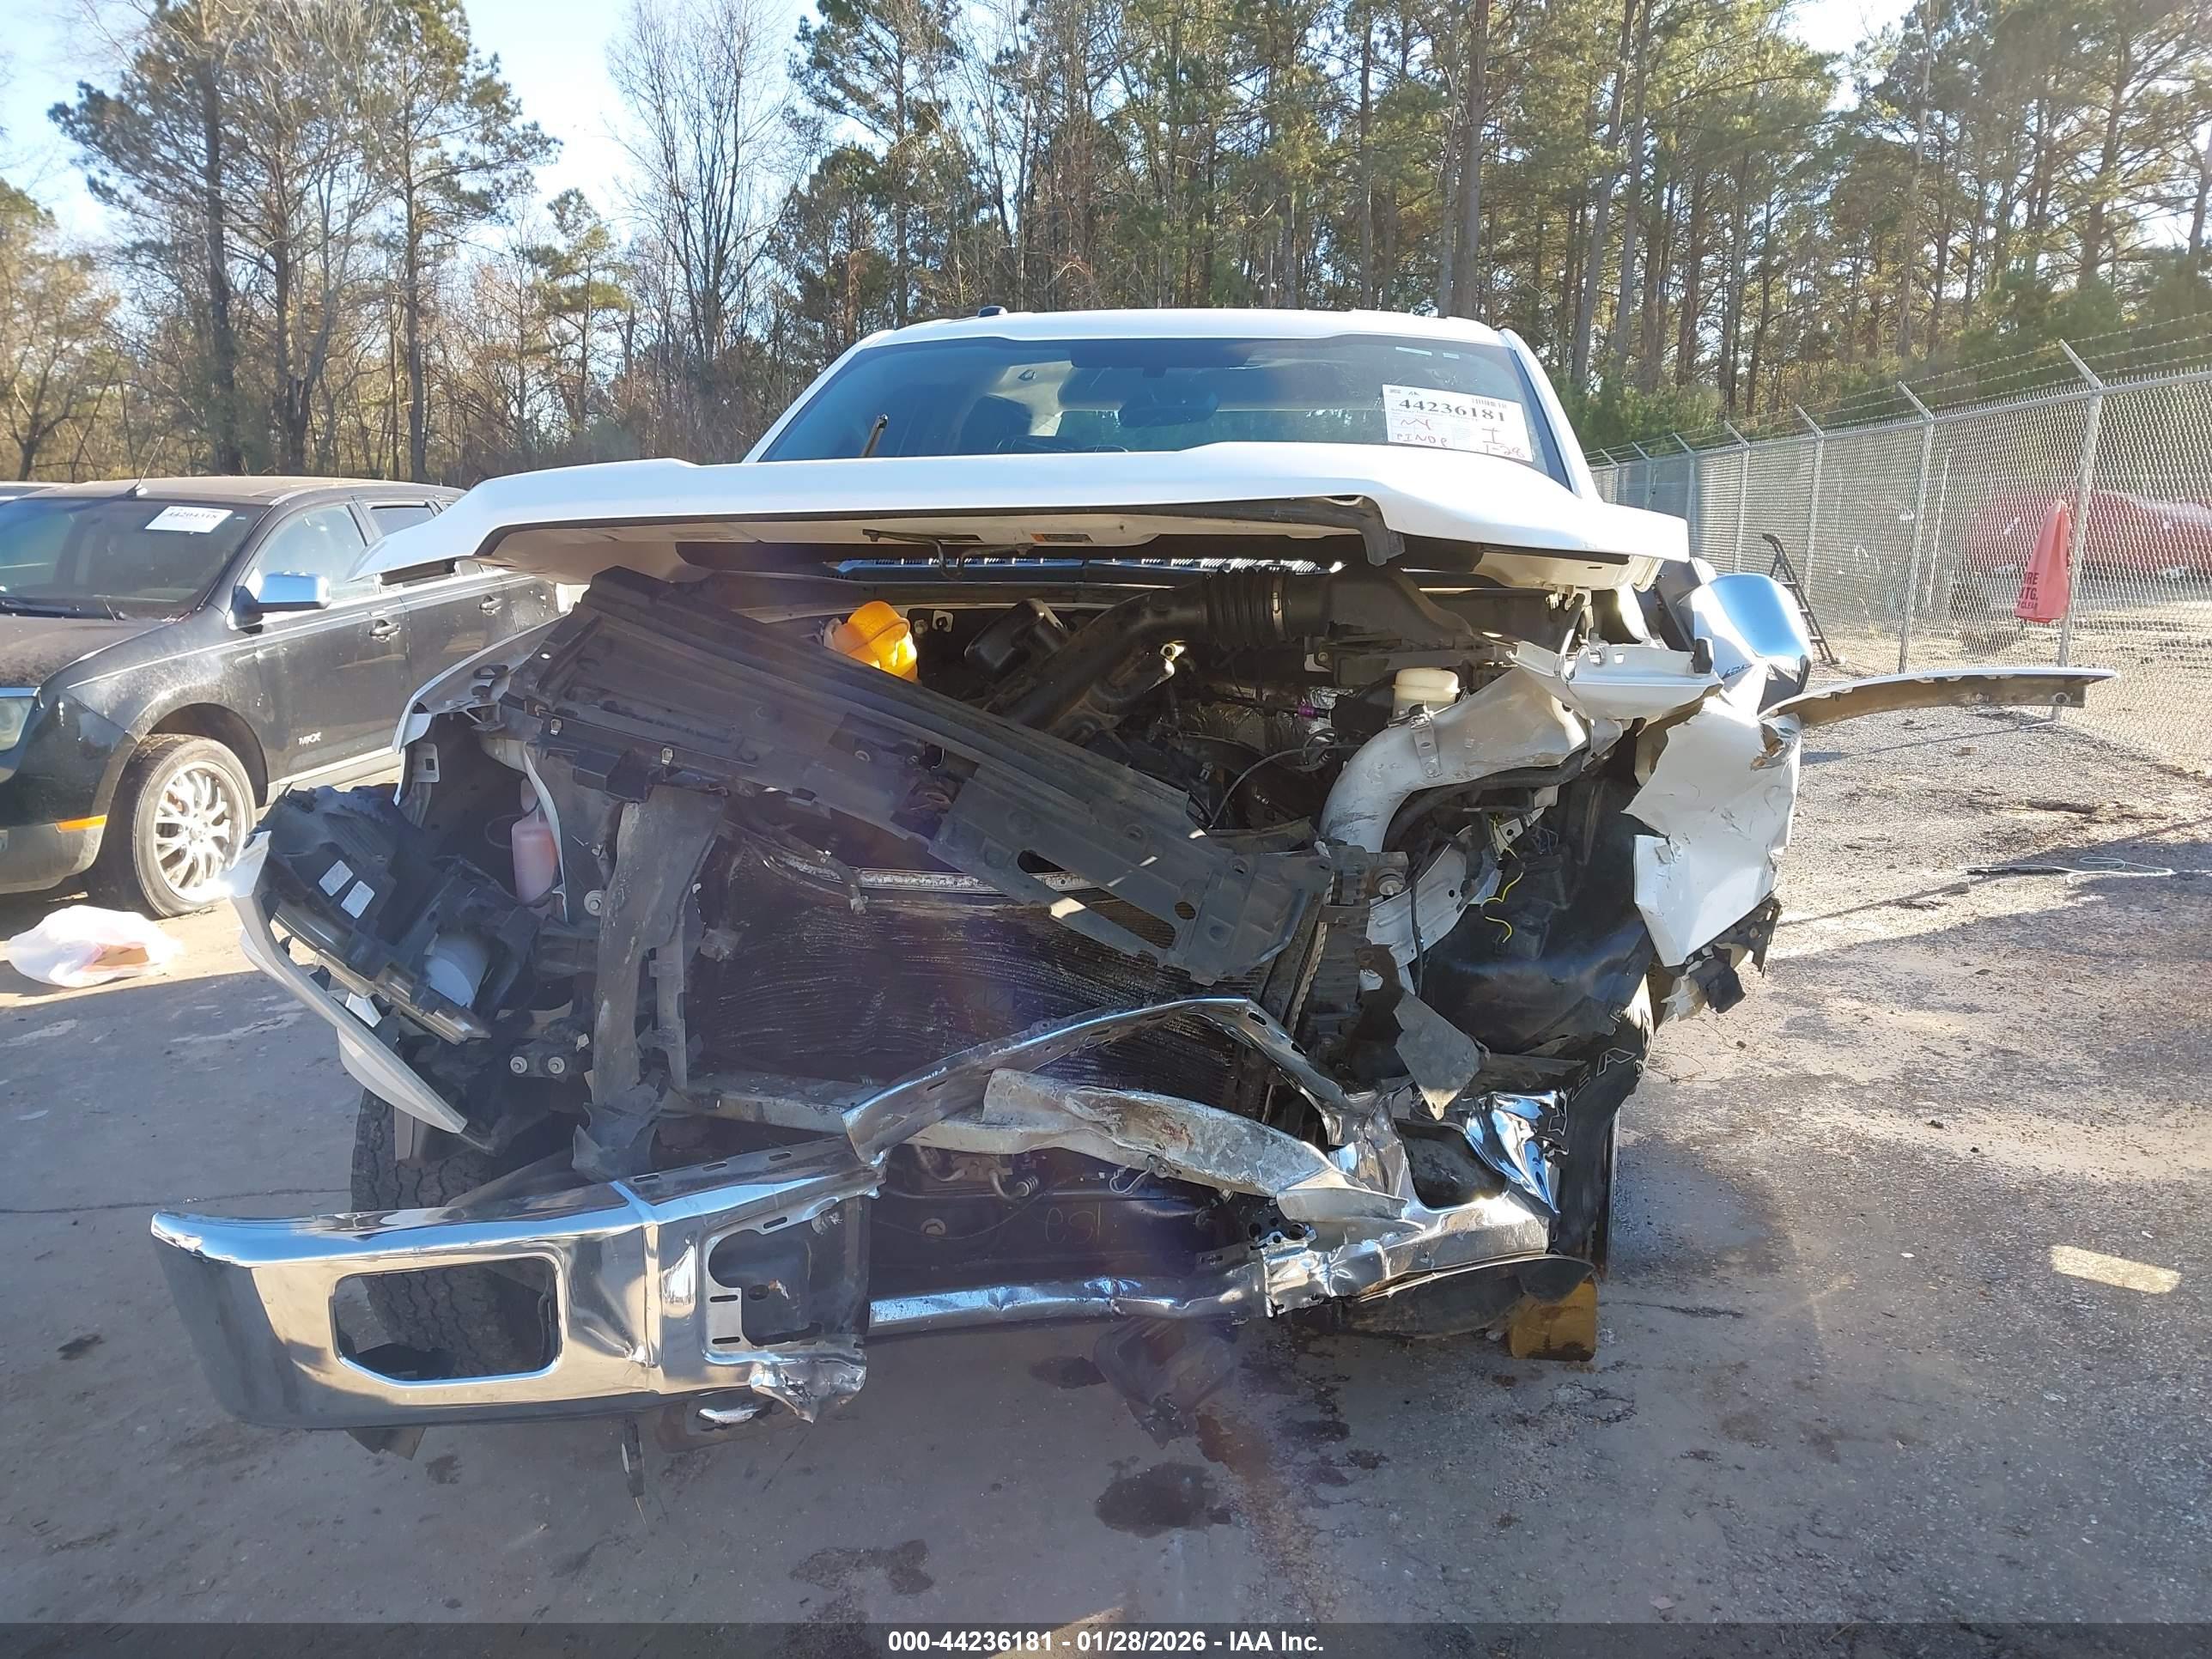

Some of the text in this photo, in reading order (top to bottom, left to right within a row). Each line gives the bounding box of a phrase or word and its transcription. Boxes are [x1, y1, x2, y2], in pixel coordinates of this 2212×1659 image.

[1399, 398, 1505, 422] 44236181
[2024, 571, 2039, 585] IRE
[2019, 586, 2039, 601] XTG.
